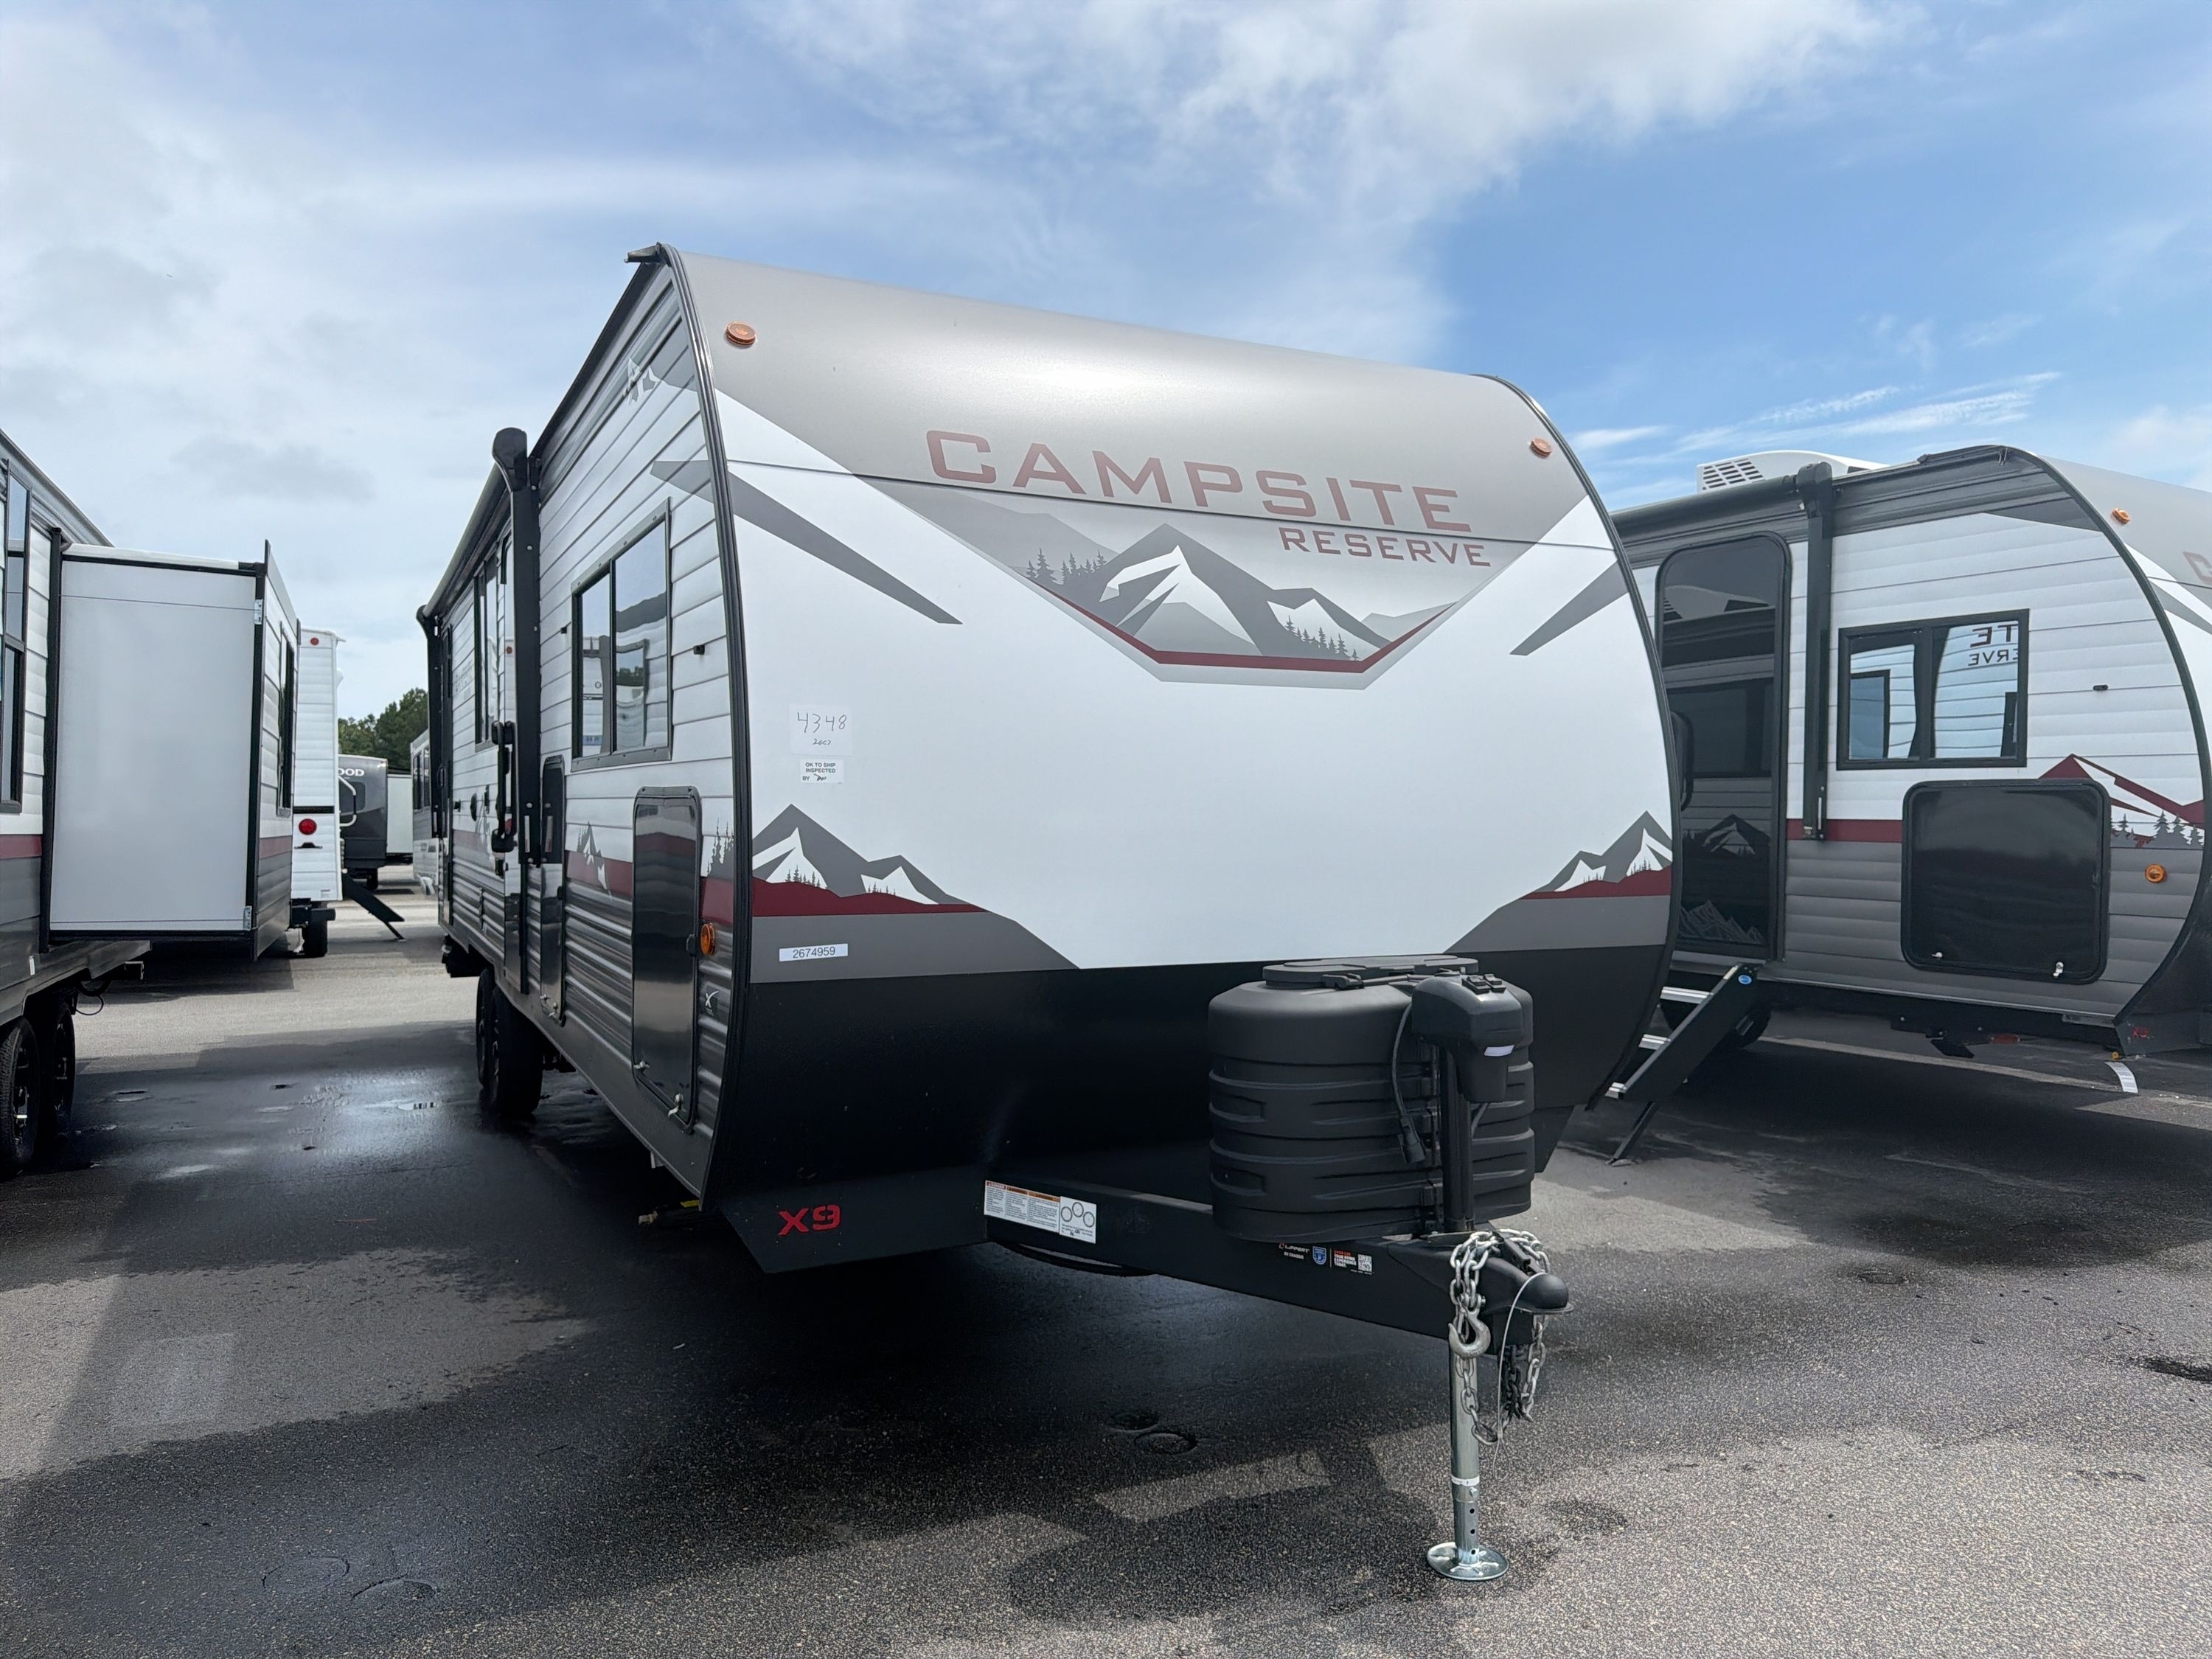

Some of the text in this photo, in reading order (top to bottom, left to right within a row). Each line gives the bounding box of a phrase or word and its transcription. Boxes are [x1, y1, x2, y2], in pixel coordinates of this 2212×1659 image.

[926, 430, 1472, 532] CAMPSITE
[1279, 527, 1491, 566] RESERVE
[797, 712, 847, 733] 4348
[793, 946, 835, 959] 2674959
[779, 1205, 840, 1235] X9
[1284, 1245, 1310, 1253] LIPPERT
